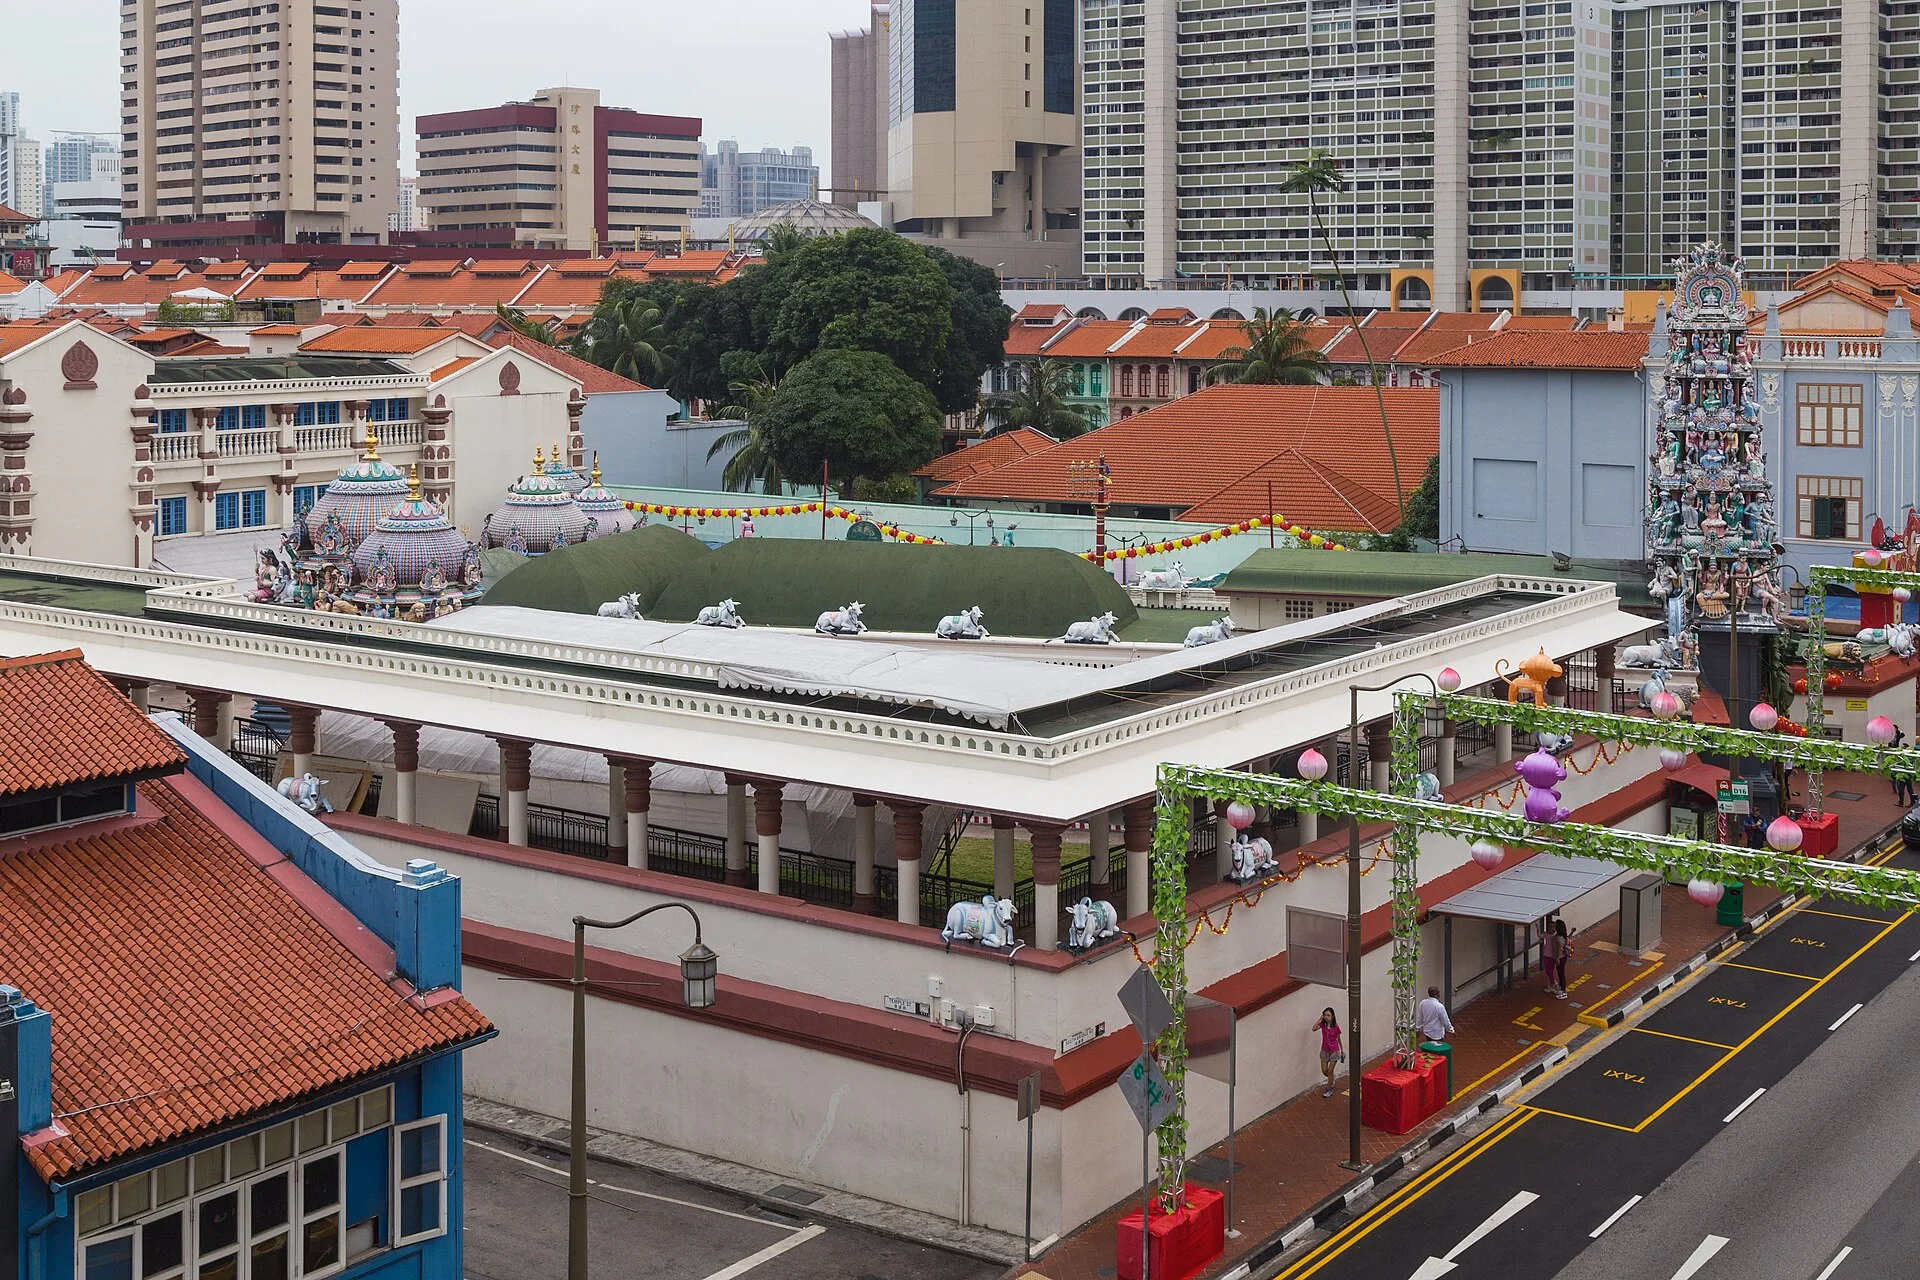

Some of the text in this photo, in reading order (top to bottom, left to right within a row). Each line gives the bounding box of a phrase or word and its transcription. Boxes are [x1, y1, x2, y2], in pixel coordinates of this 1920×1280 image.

[1588, 7, 1594, 20] 3
[15, 256, 32, 271] 福
[1719, 803, 1725, 811] 4
[1790, 937, 1826, 948] TAXI
[1708, 996, 1746, 1009] TAXI
[1352, 1017, 1358, 1033] 32
[1603, 1069, 1645, 1084] TAXI
